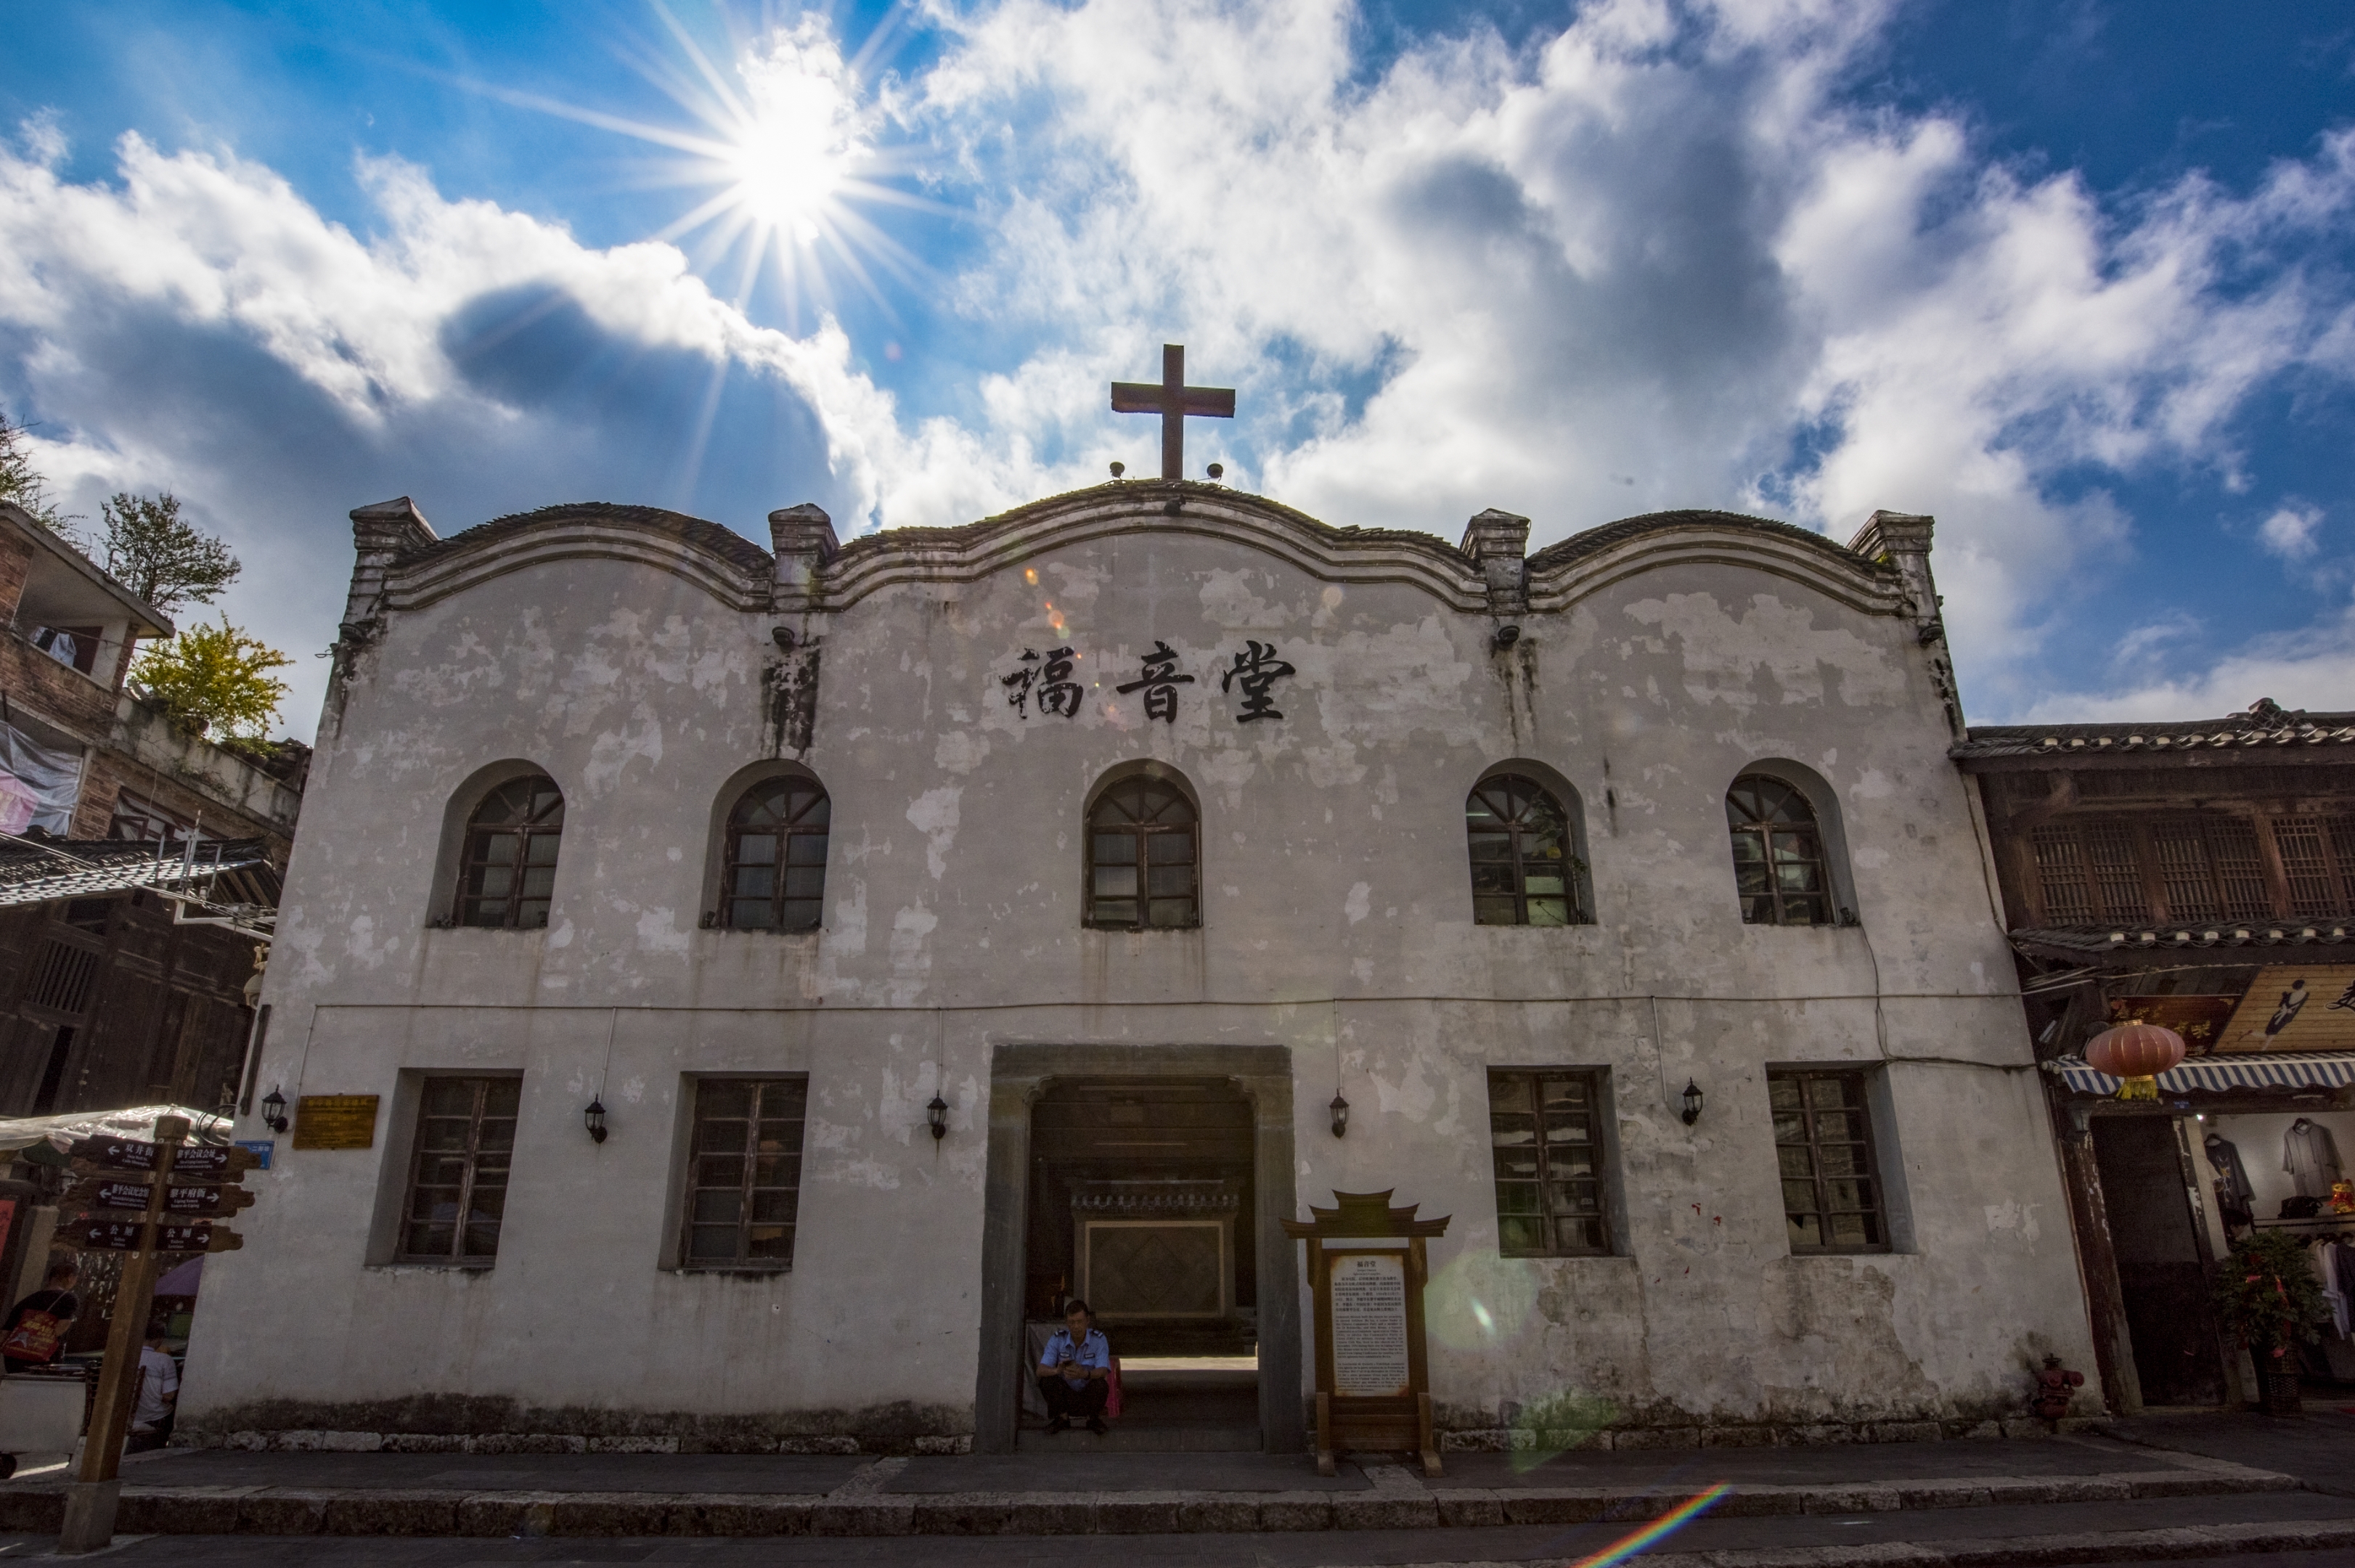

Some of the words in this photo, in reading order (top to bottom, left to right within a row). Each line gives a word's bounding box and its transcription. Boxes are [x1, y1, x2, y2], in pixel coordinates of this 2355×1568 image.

[999, 640, 1296, 724] 福音堂
[125, 1143, 154, 1156] 双井街
